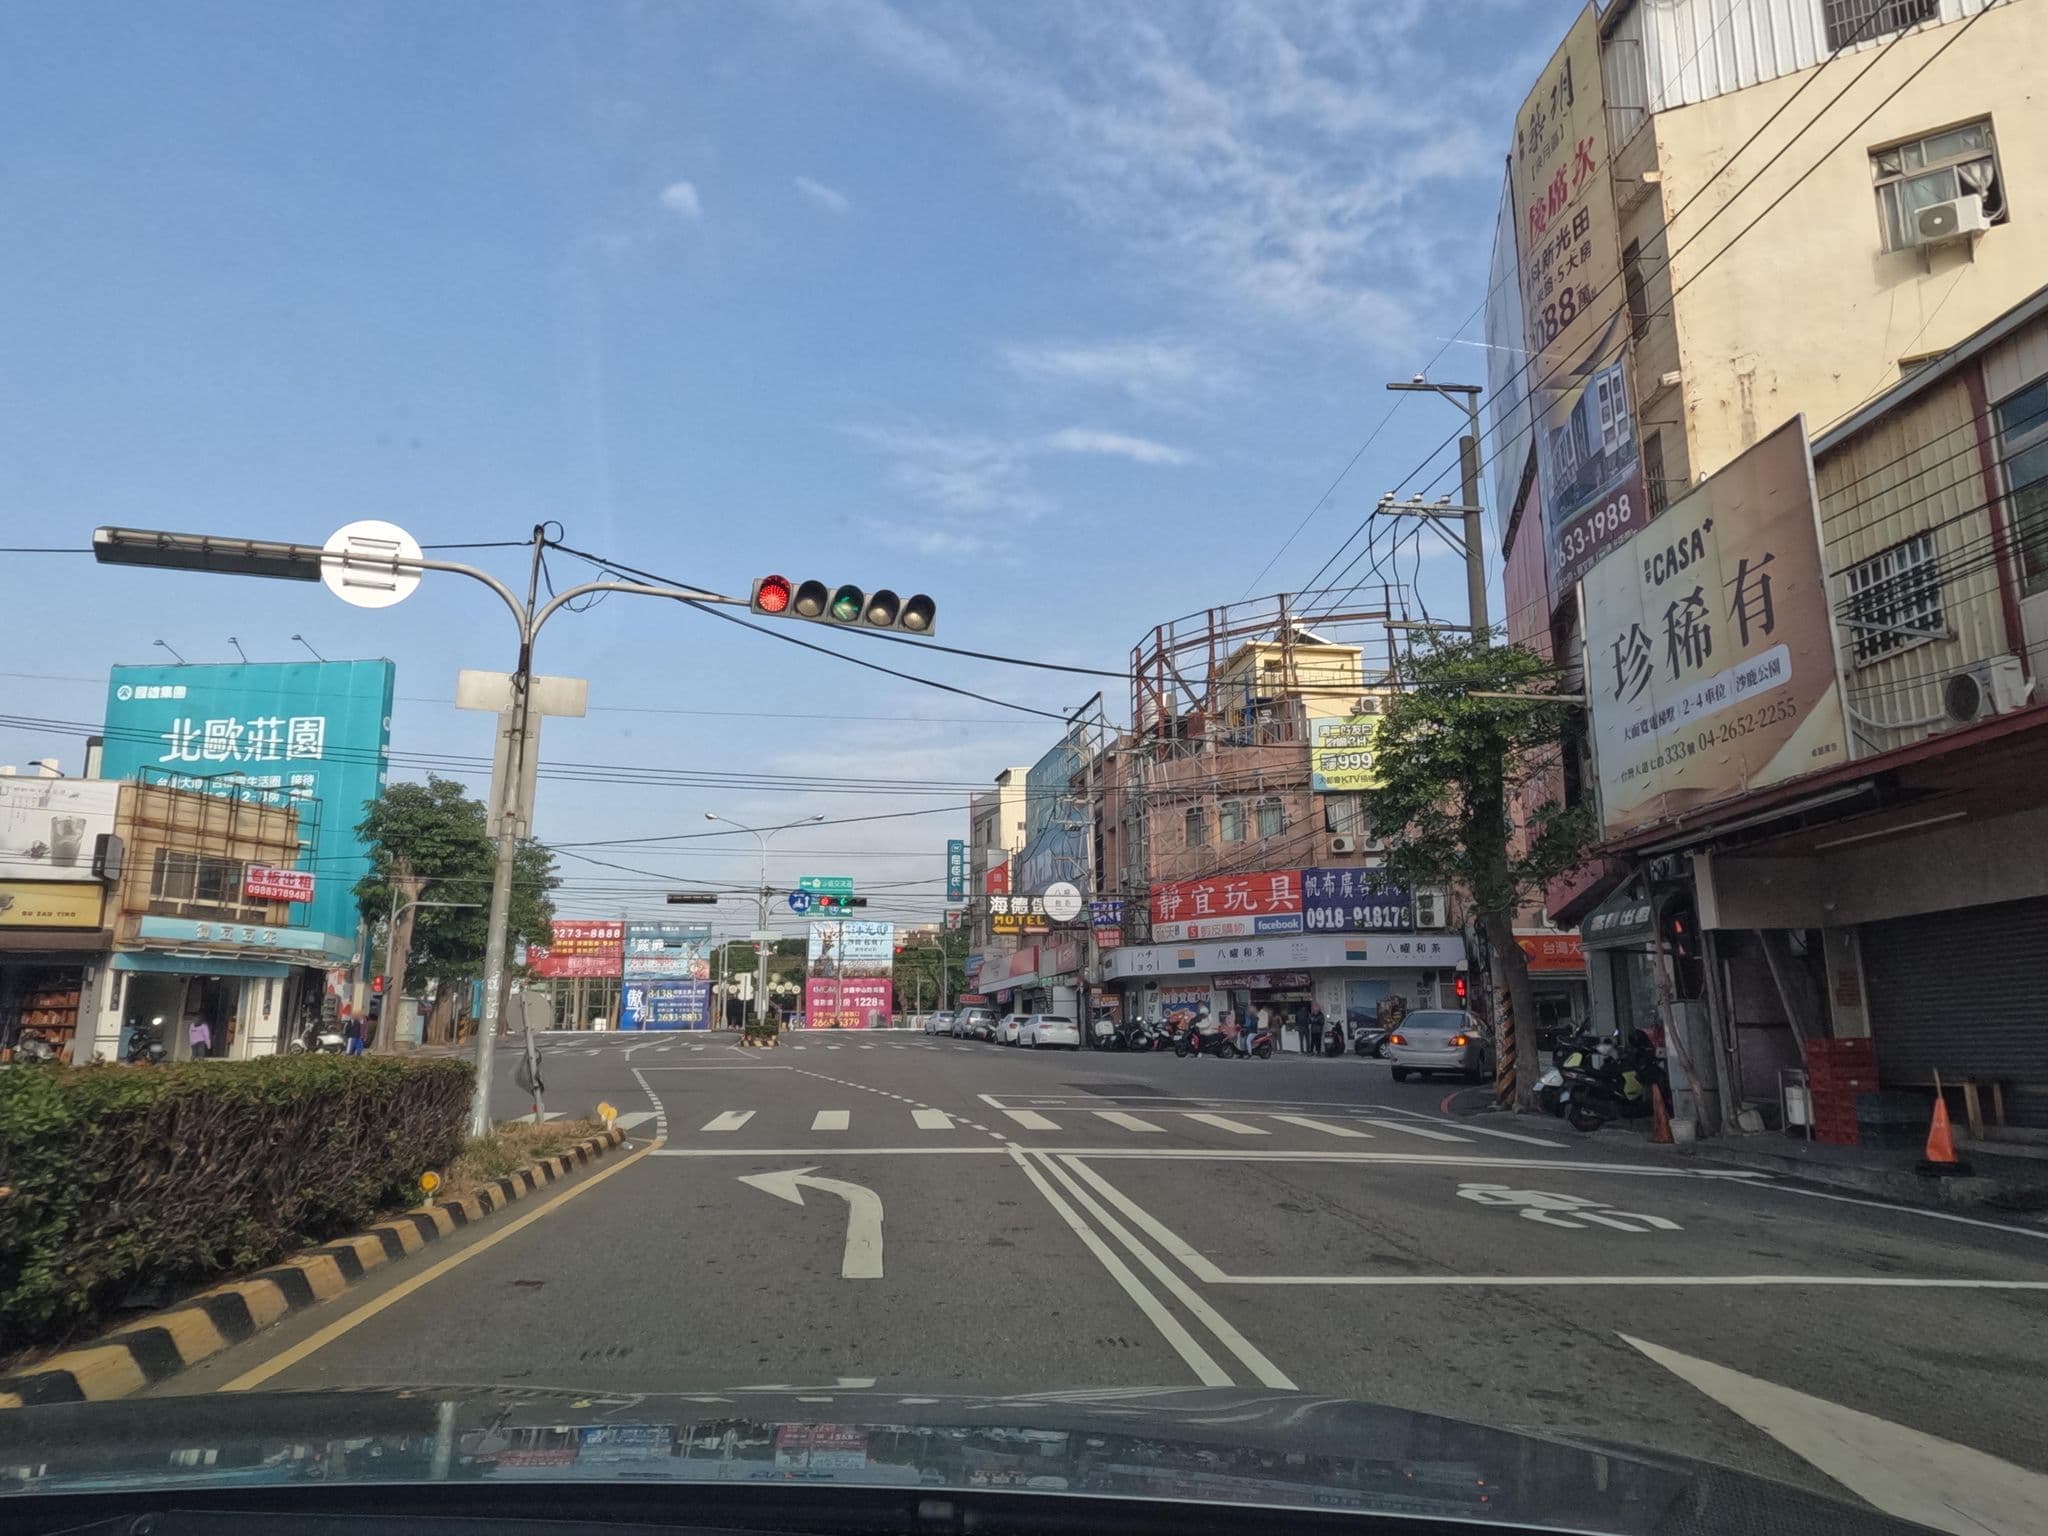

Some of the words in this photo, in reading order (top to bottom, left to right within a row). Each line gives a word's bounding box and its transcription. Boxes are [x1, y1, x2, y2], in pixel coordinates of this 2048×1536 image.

[1609, 551, 1776, 706] 珍稀有
[1682, 683, 1726, 717] 2-4車位
[1735, 656, 1781, 694] 沙鹿公園
[159, 716, 326, 763] 北歐莊園
[1698, 697, 1798, 752] 04-2652-2255
[1337, 752, 1373, 771] 999
[1158, 875, 1299, 921] 靜宜玩具
[994, 915, 1046, 925] MOTEL
[1258, 919, 1299, 930] facebook
[1217, 946, 1265, 959] 八曜和茶
[1385, 943, 1441, 954] 八曜和茶
